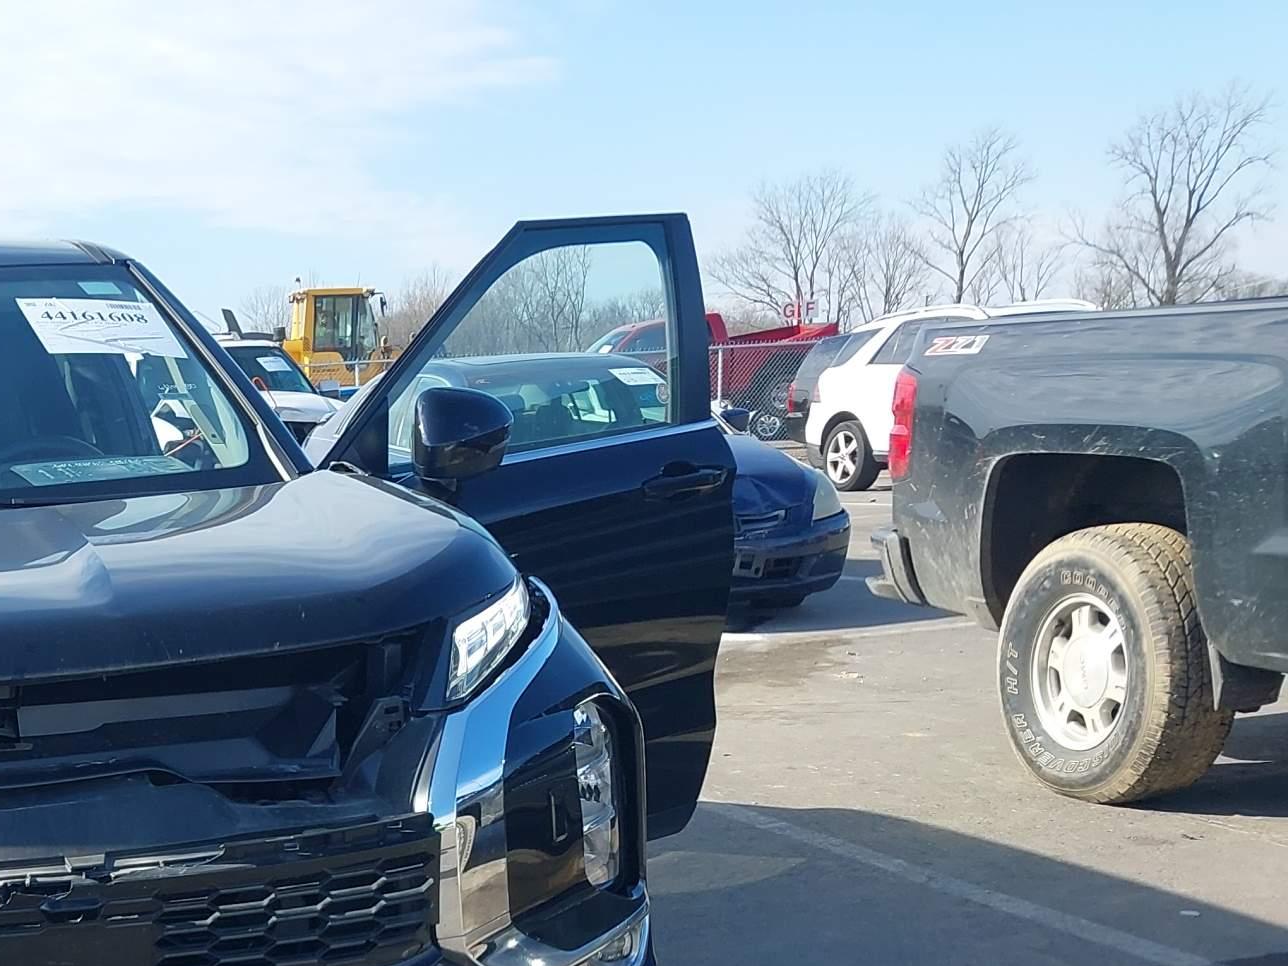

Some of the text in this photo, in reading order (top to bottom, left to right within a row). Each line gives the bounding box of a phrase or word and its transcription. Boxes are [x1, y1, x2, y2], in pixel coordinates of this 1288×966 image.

[40, 310, 149, 324] 44161608
[783, 302, 815, 318] G F
[923, 334, 991, 356] Z71
[1006, 641, 1019, 696] H/T
